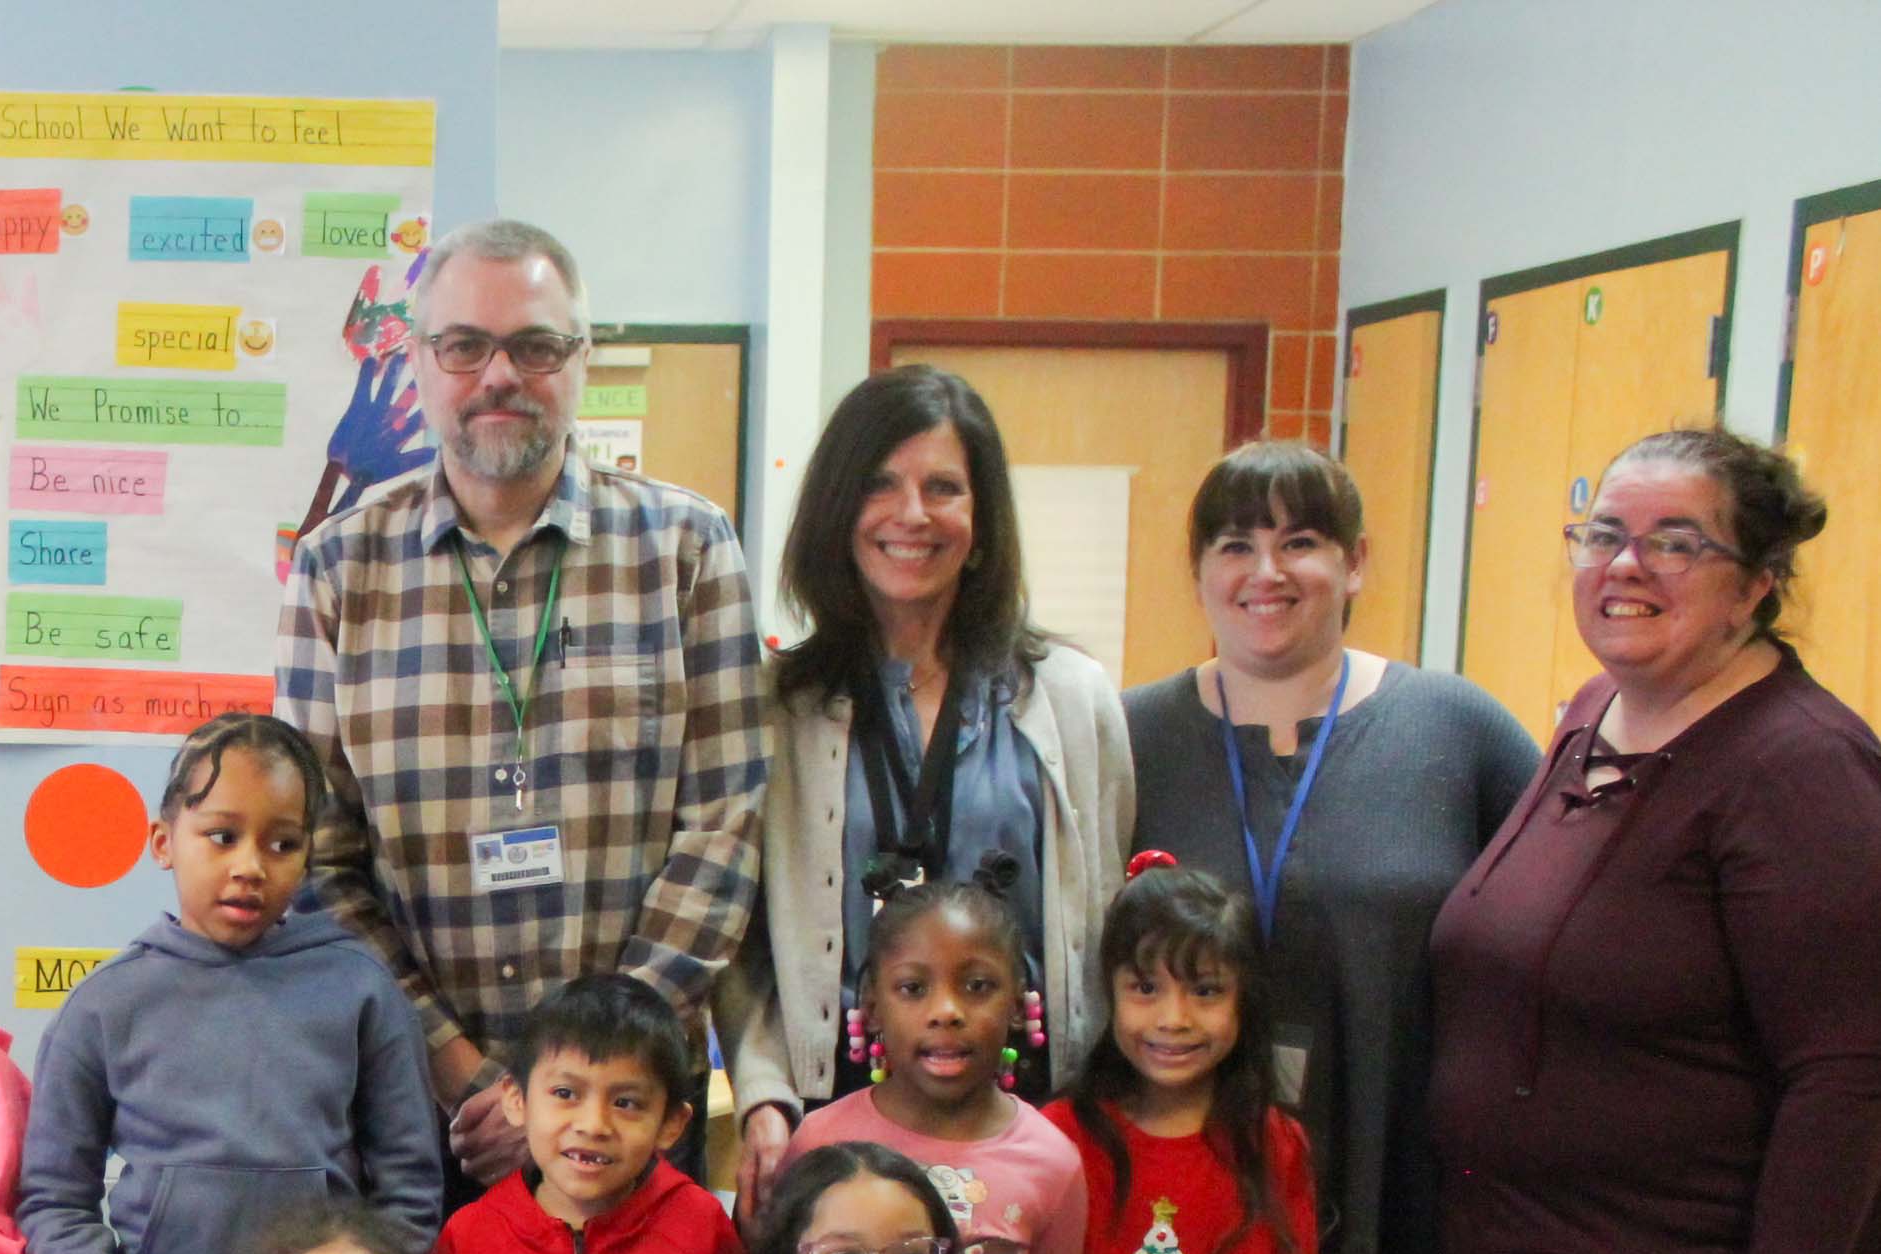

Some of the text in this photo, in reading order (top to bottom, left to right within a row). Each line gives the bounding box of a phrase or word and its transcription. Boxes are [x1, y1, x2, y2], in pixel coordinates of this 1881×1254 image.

[0, 104, 84, 140] School
[104, 105, 141, 141] We
[162, 107, 227, 142] Want
[251, 108, 276, 143] to
[141, 216, 246, 254] excited
[321, 210, 390, 249] loved
[133, 316, 232, 361] special
[28, 387, 61, 421] We
[93, 388, 191, 425] Promise
[29, 456, 147, 497] Be nice
[19, 530, 94, 566] Share
[24, 610, 171, 651] Be safe
[7, 676, 70, 728] Sign
[92, 694, 126, 714] as
[144, 681, 213, 719] much
[35, 957, 102, 992] MO
